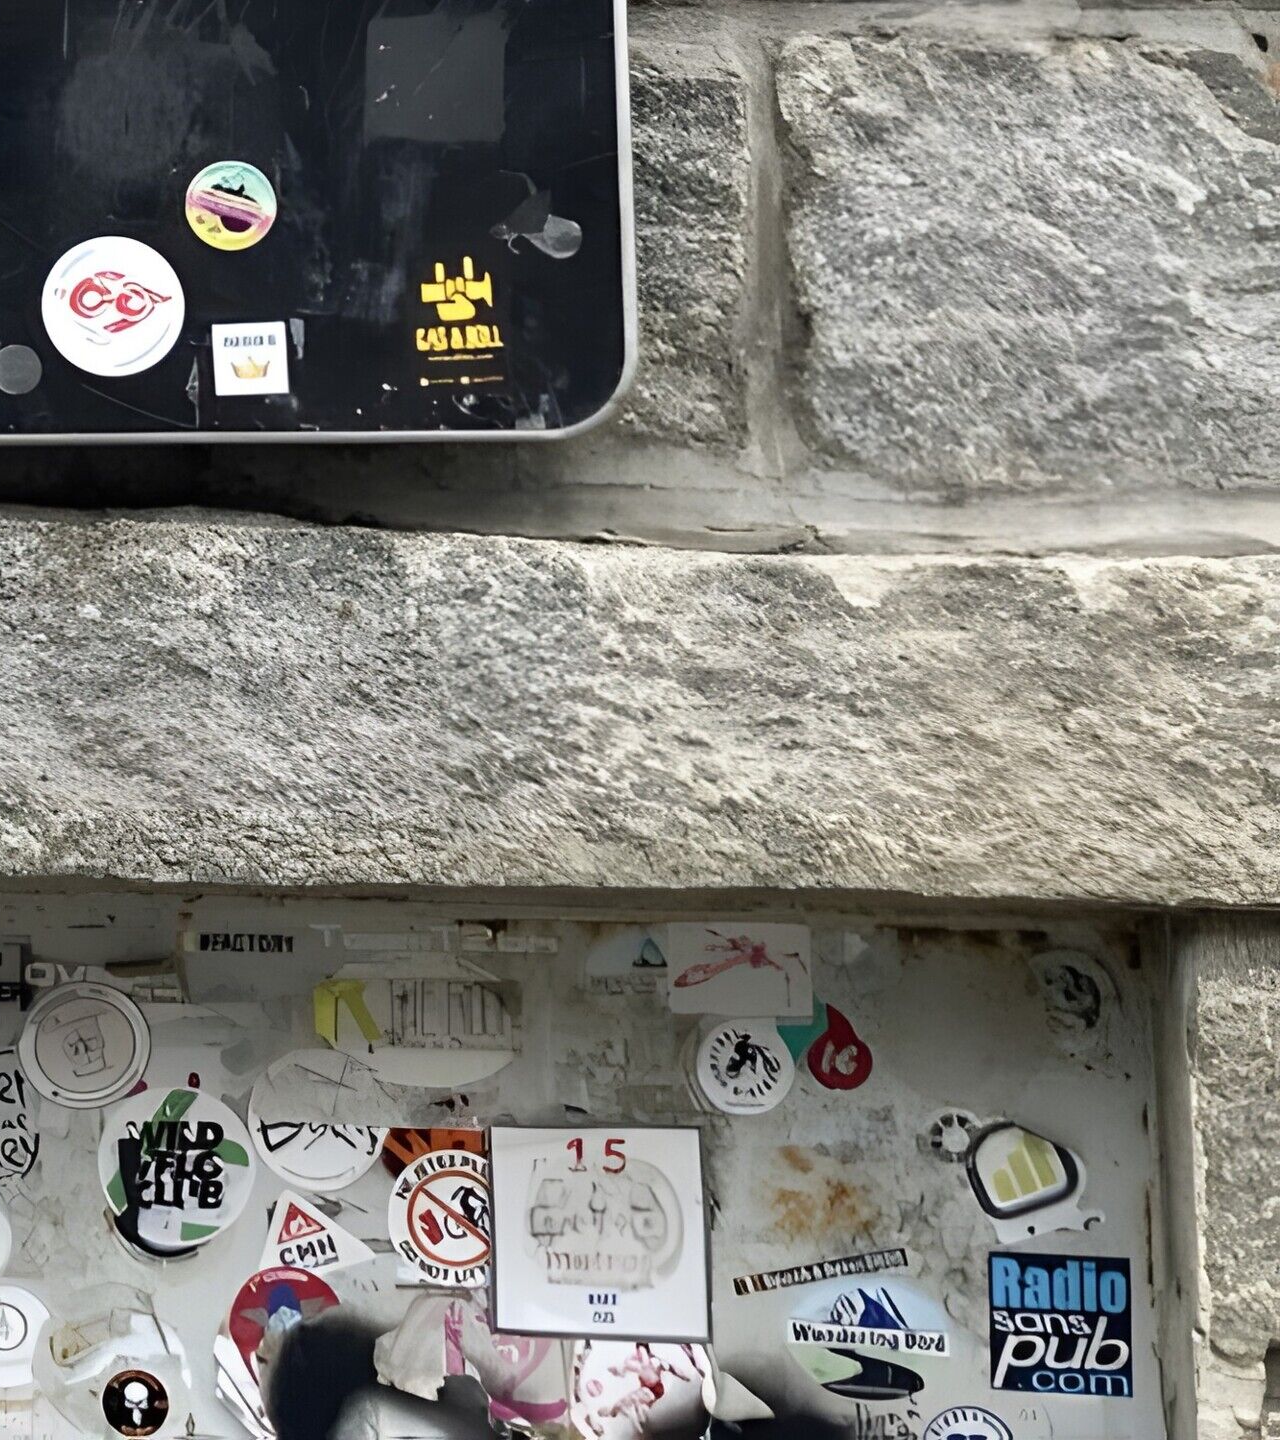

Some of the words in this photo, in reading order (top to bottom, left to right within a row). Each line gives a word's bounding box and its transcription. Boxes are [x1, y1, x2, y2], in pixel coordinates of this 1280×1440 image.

[991, 1256, 1127, 1314] Radio
[992, 1310, 1092, 1335] sans
[993, 1316, 1130, 1388] pub
